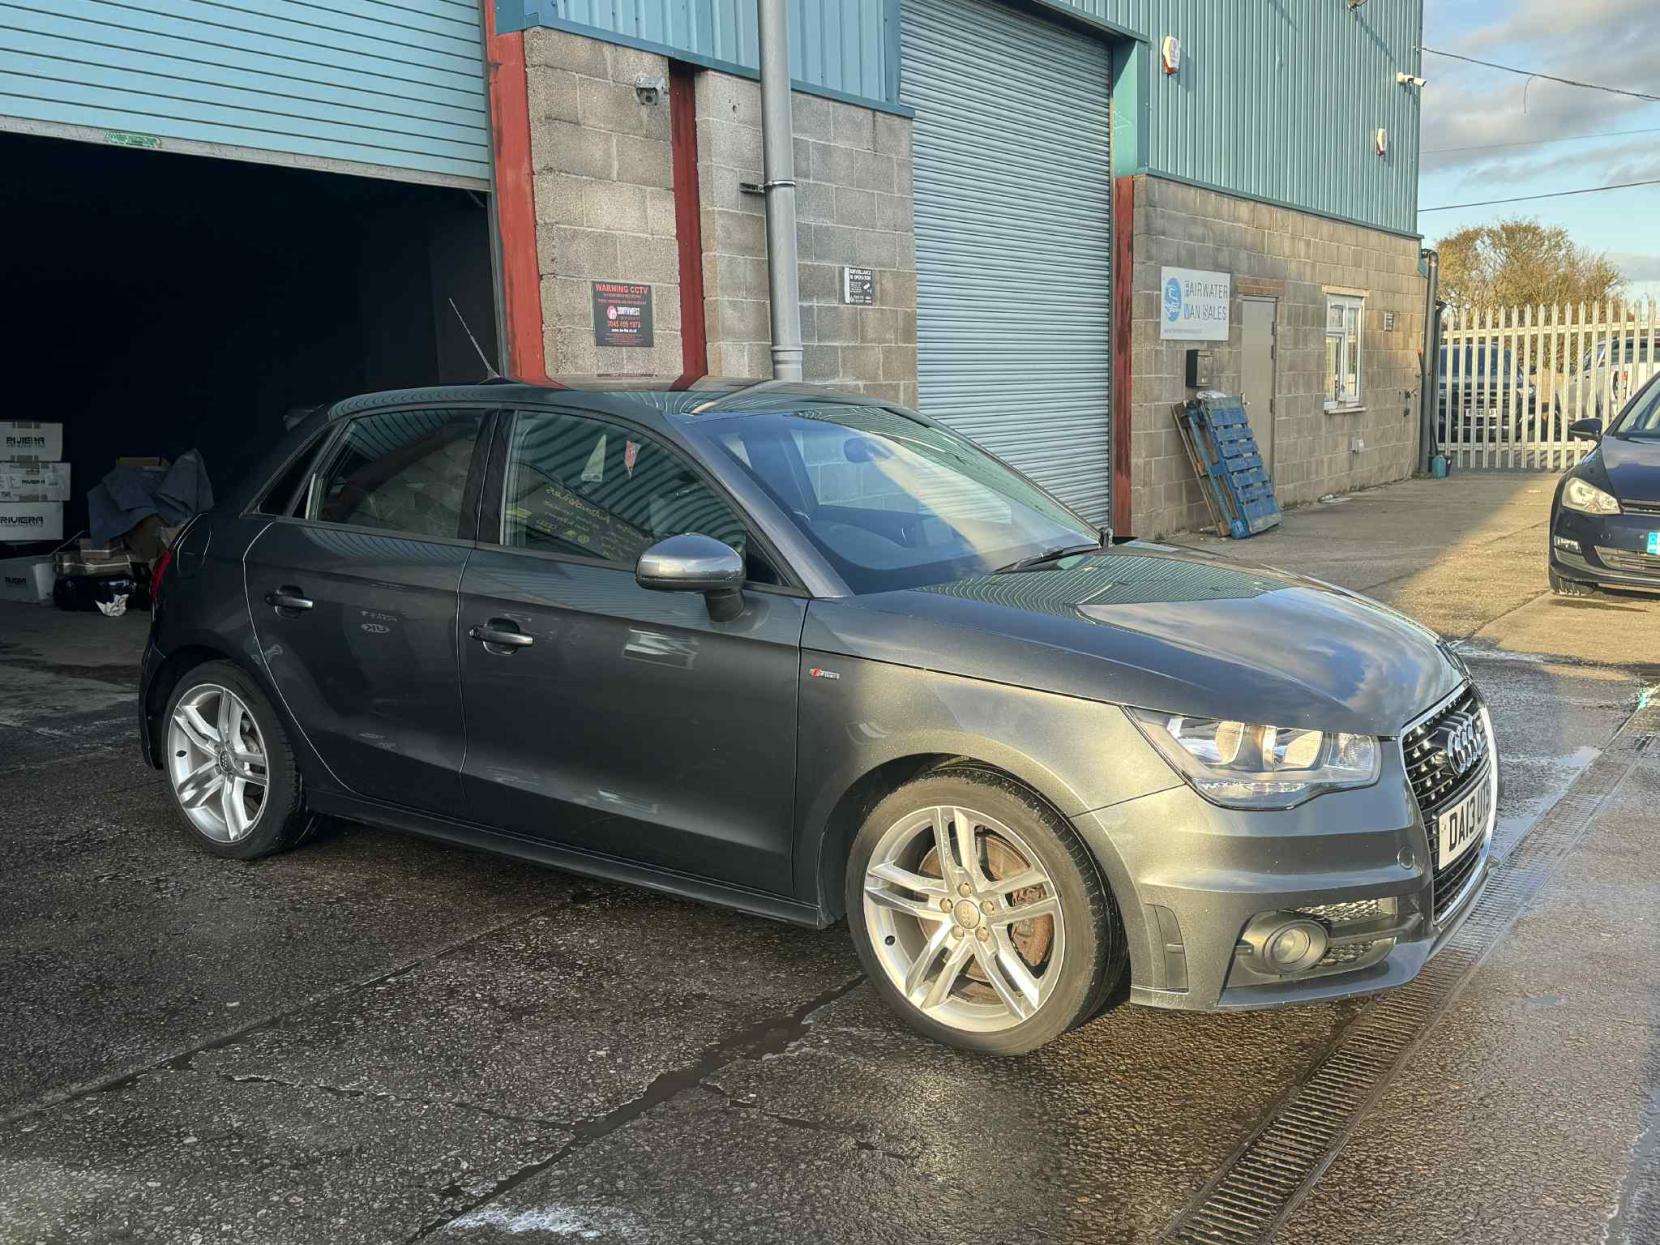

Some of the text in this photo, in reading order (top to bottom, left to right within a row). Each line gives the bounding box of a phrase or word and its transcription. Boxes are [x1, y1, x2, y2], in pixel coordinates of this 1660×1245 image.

[595, 283, 649, 294] WARNING CCTV
[1202, 304, 1226, 320] SALES
[1449, 796, 1475, 852] DA13
